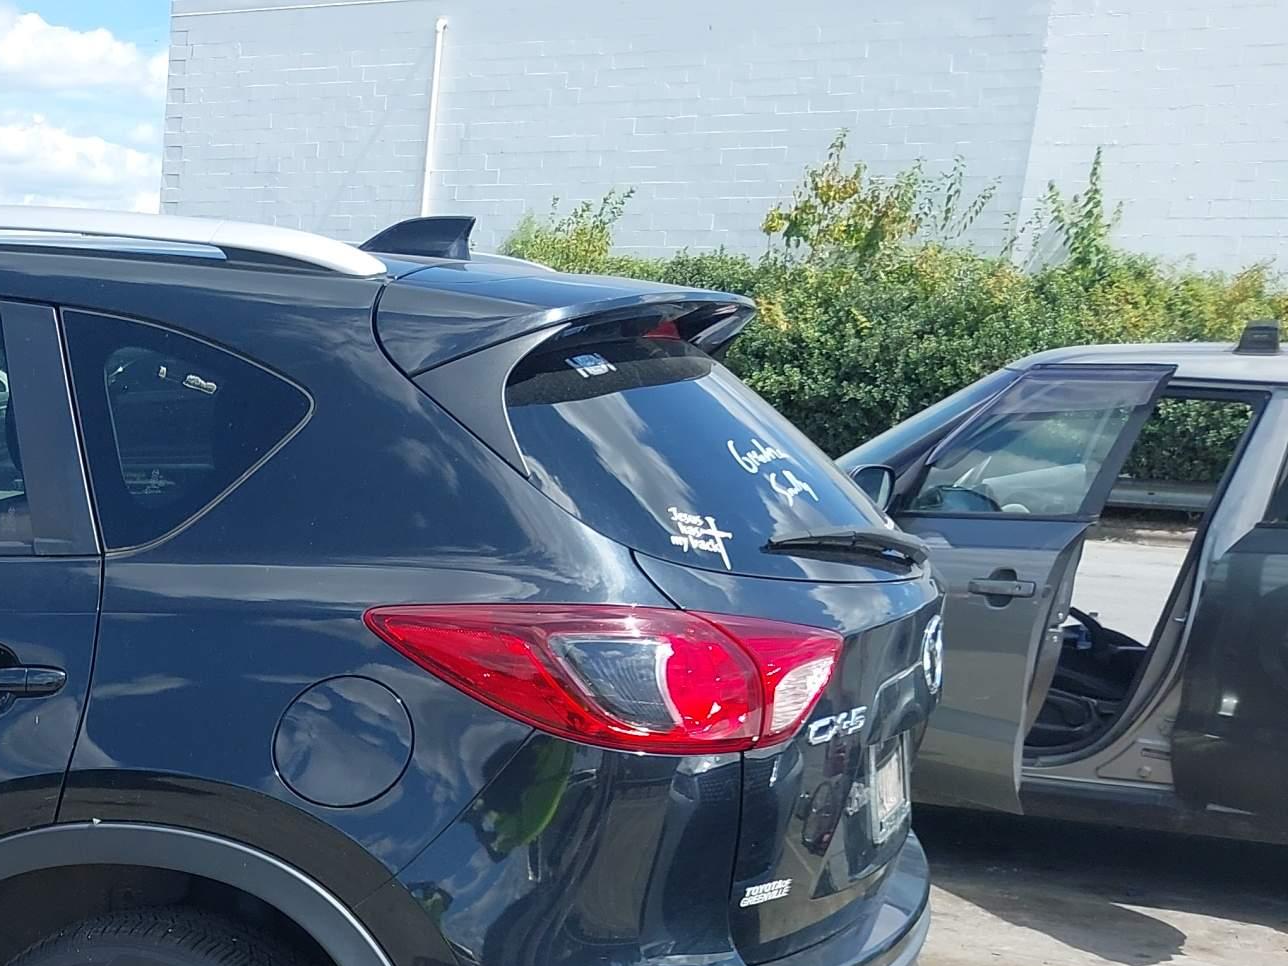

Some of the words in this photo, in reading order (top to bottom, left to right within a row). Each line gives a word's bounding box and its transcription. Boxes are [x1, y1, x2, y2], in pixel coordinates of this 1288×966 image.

[667, 506, 704, 526] Jesus
[670, 535, 689, 553] my
[688, 535, 722, 553] back
[808, 705, 868, 745] CX-5
[745, 880, 780, 897] TOYOTA
